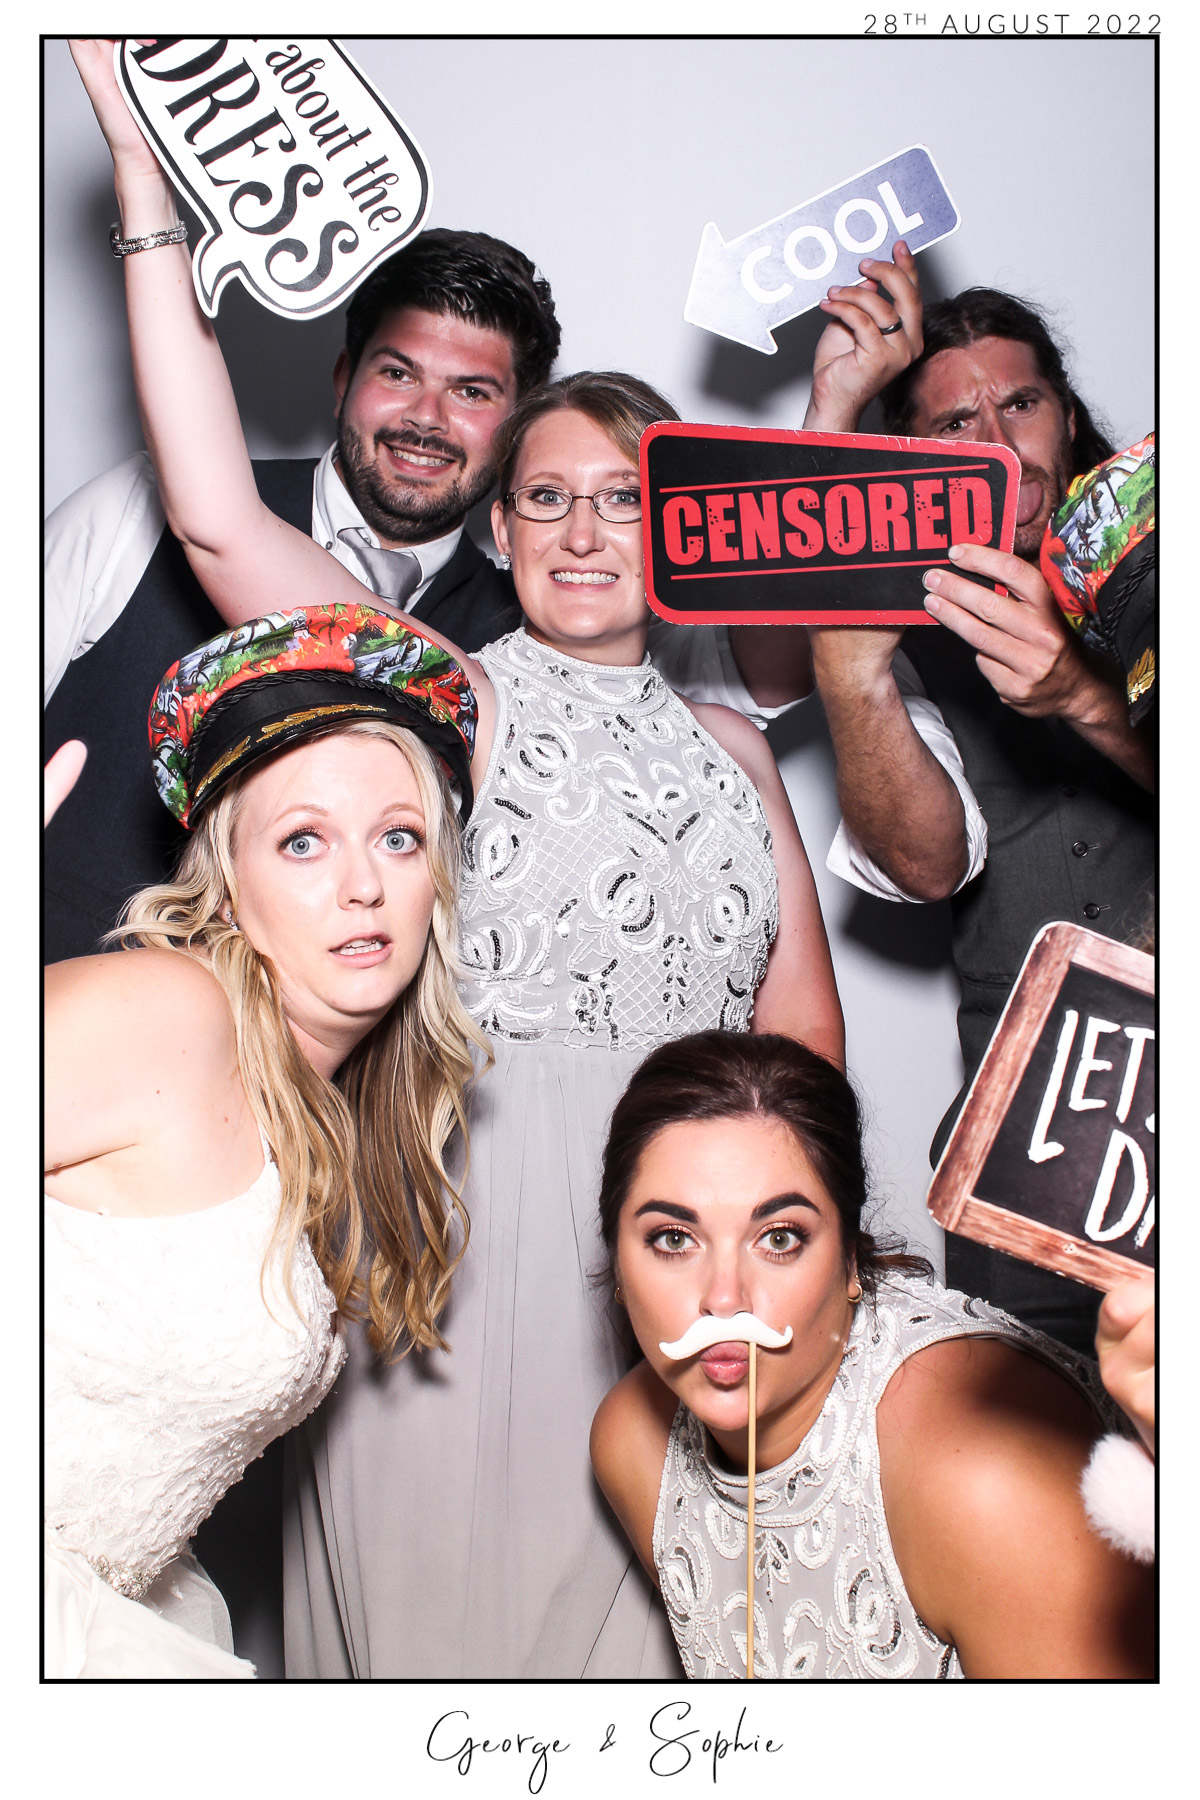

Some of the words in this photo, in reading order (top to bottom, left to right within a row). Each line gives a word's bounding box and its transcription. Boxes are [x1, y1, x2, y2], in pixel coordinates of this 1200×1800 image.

[129, 39, 361, 293] DRESS
[264, 43, 372, 162] about
[342, 153, 402, 232] the
[740, 180, 925, 304] COOL
[662, 476, 994, 567] CENSORED
[1028, 1008, 1155, 1164] LET
